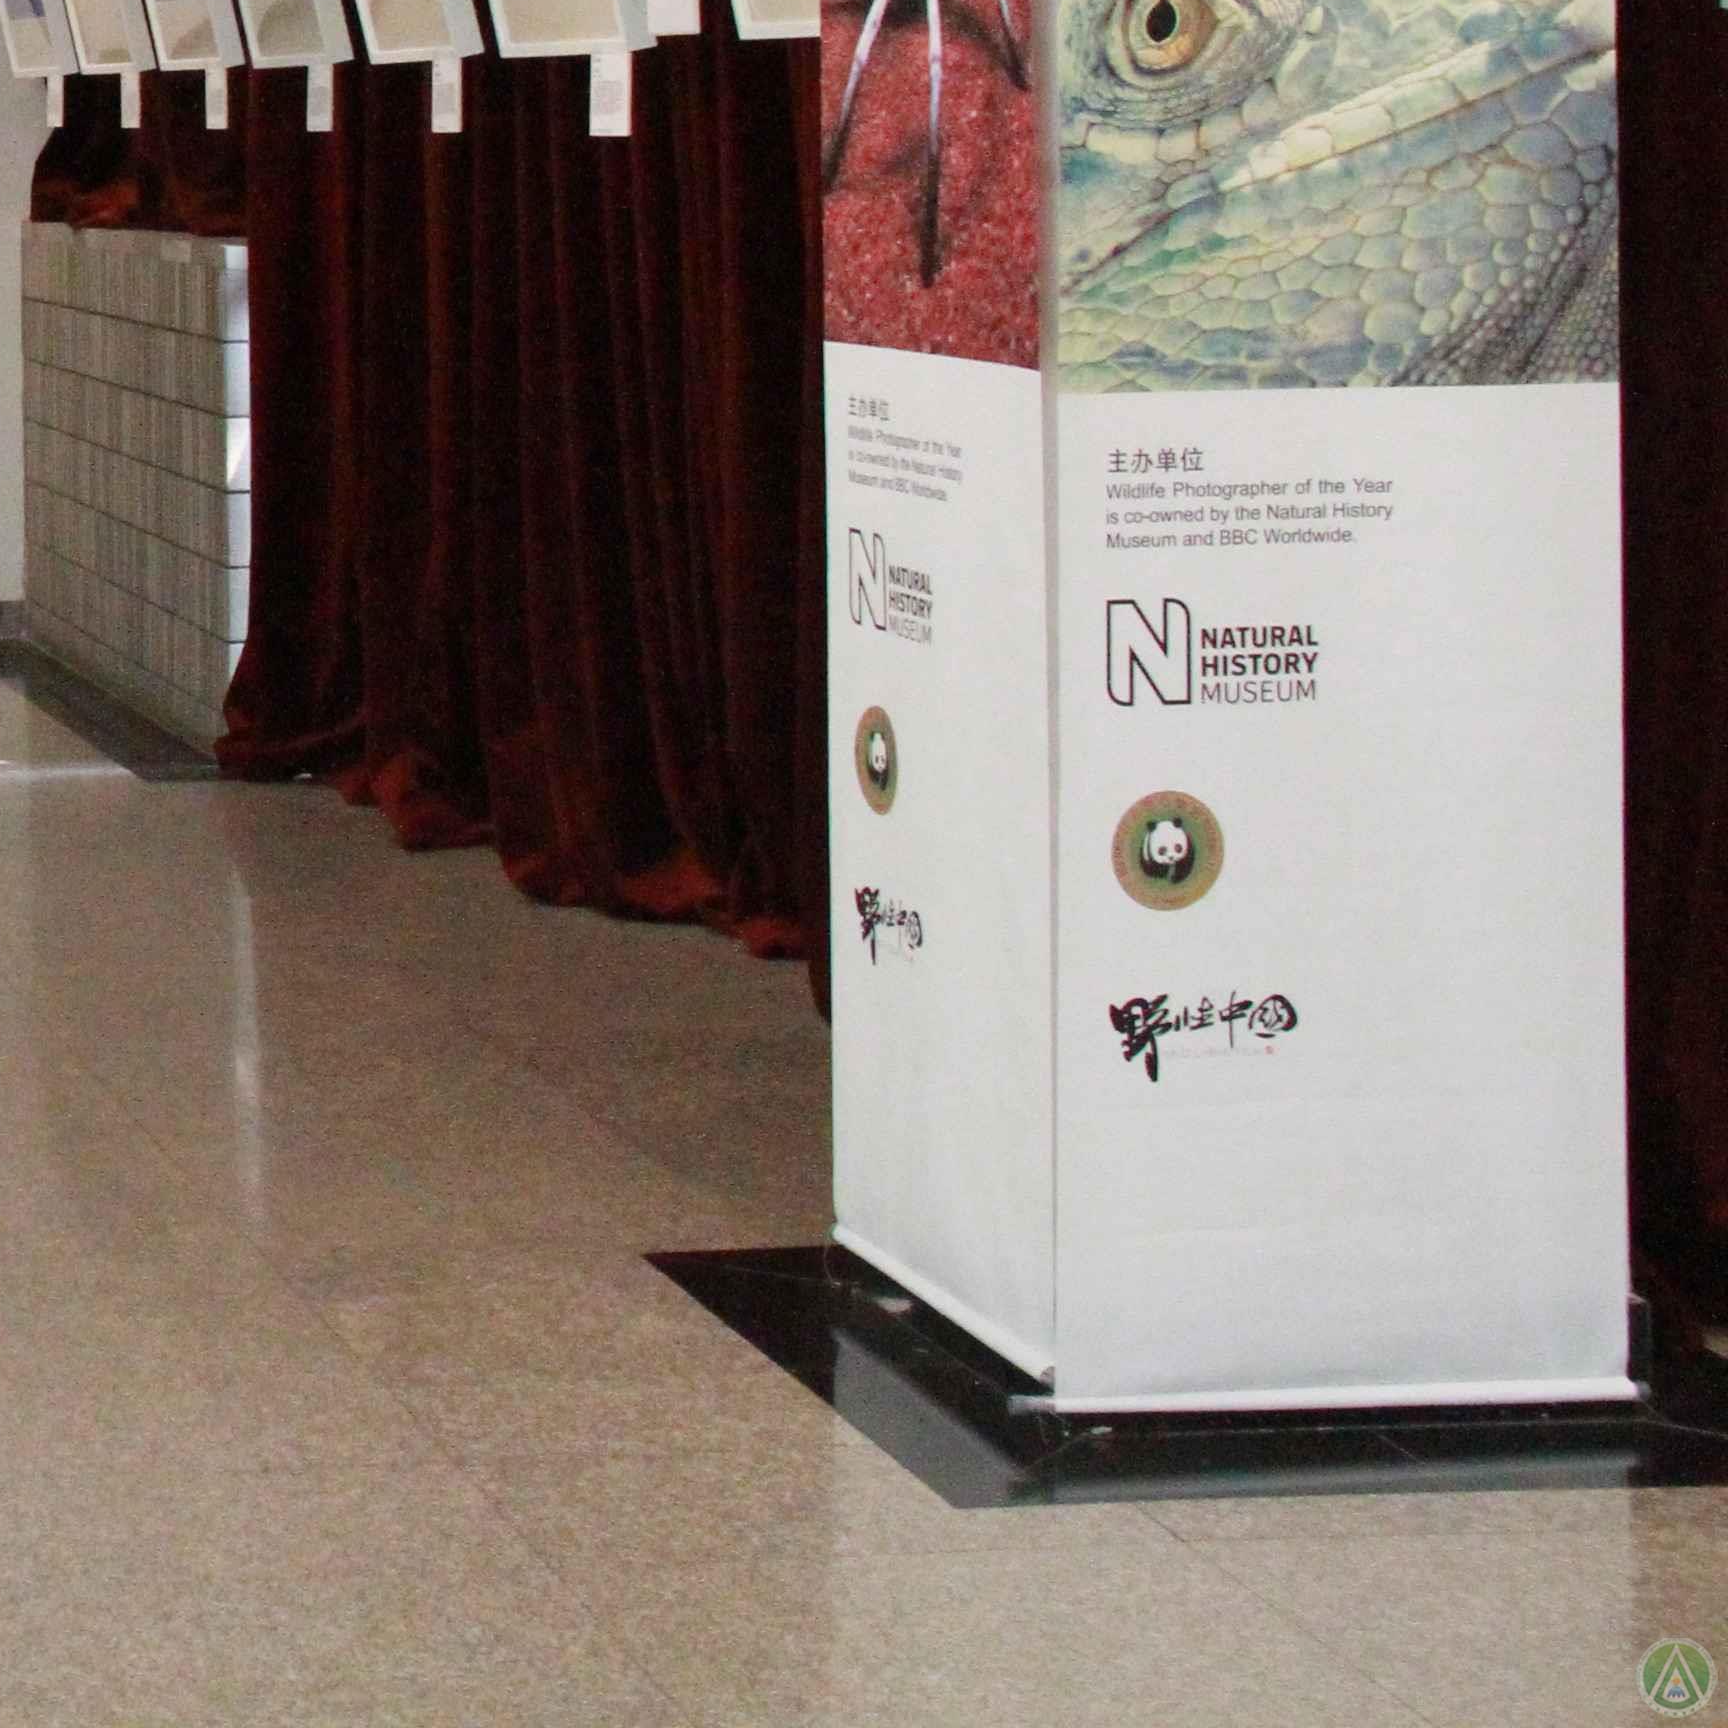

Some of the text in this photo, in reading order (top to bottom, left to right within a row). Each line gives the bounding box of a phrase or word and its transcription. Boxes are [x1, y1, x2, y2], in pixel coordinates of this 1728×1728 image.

[1107, 447, 1204, 473] 主办单位
[1106, 477, 1393, 500] Wildlife Photographer of the Year
[1105, 503, 1393, 525] is co-owned by the Natural History
[1106, 532, 1177, 549] Museum
[1182, 530, 1215, 547] and
[1220, 528, 1258, 546] BBC
[888, 564, 933, 595] NATURAL
[888, 590, 933, 619] HISTORY
[1201, 624, 1320, 649] NATURAL
[1201, 651, 1320, 677] HISTORY
[1200, 678, 1317, 705] MUSEUM
